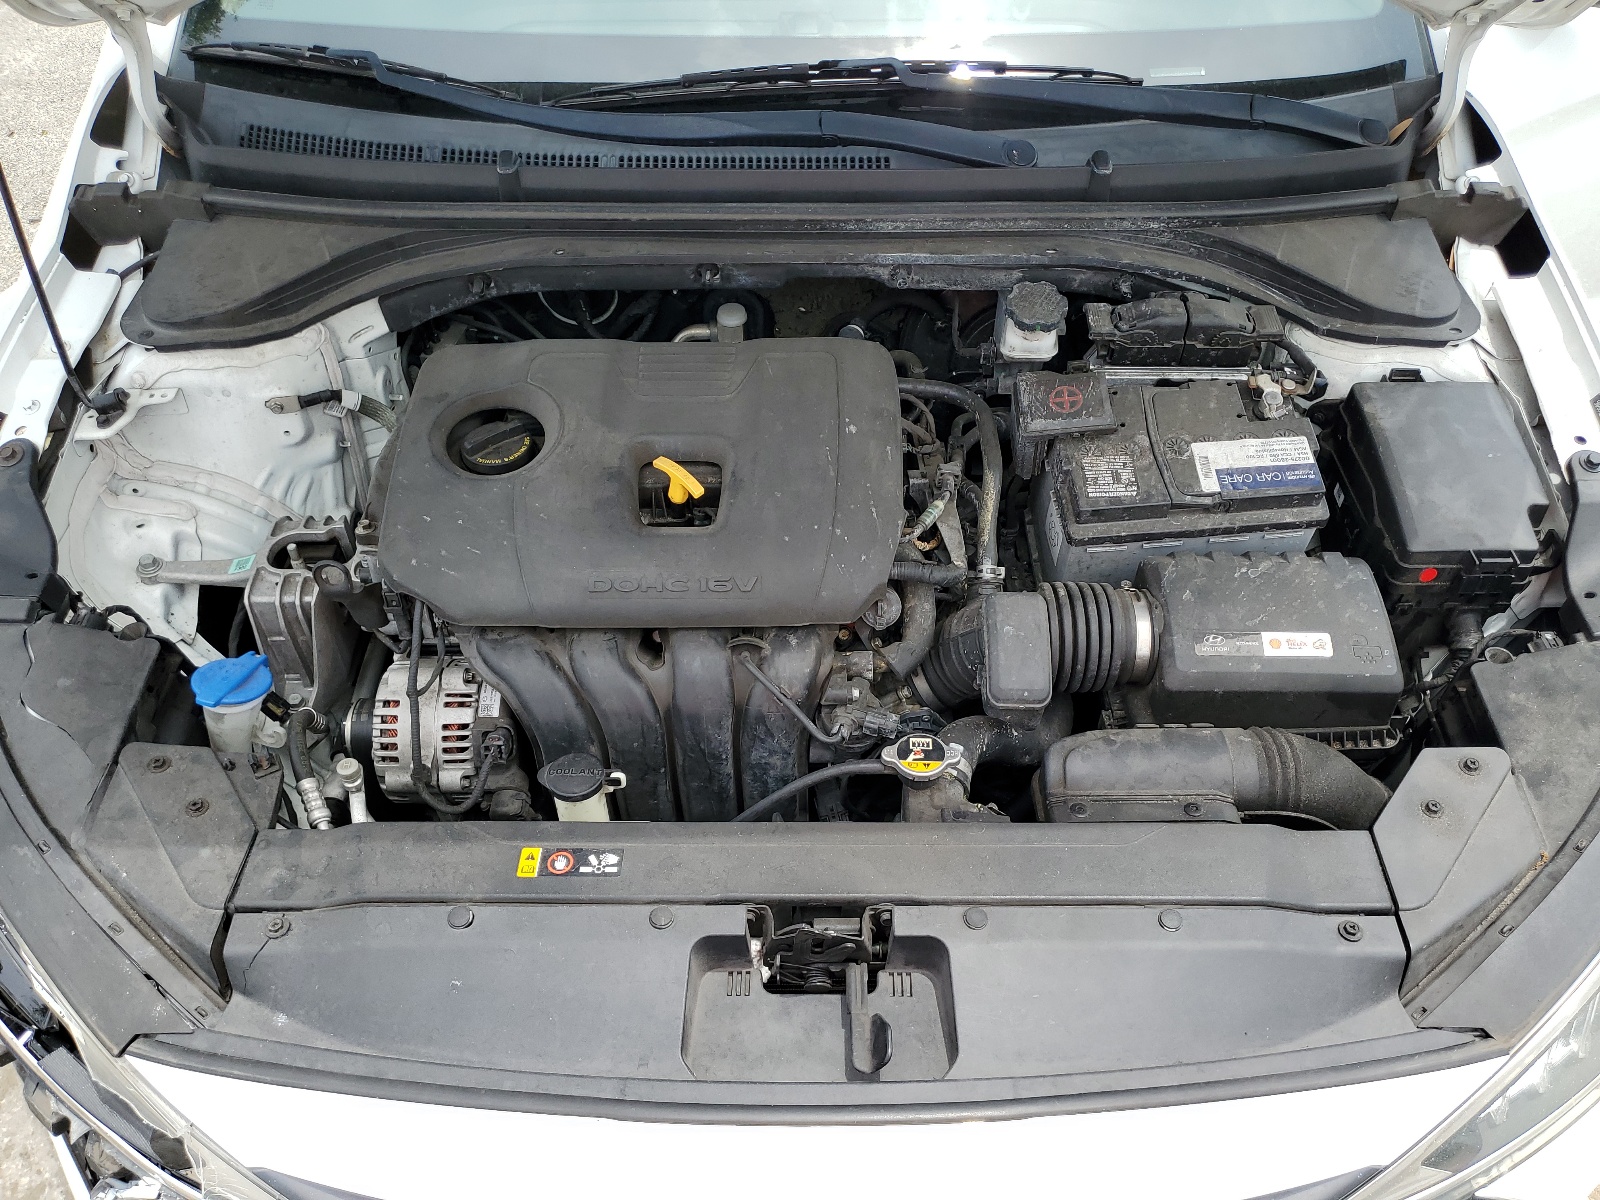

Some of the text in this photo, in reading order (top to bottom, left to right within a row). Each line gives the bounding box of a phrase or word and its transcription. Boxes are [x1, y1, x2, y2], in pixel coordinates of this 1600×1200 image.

[1219, 472, 1281, 484] CAR CARE
[588, 574, 758, 593] DOHC 16V
[547, 767, 603, 777] COOLANT
